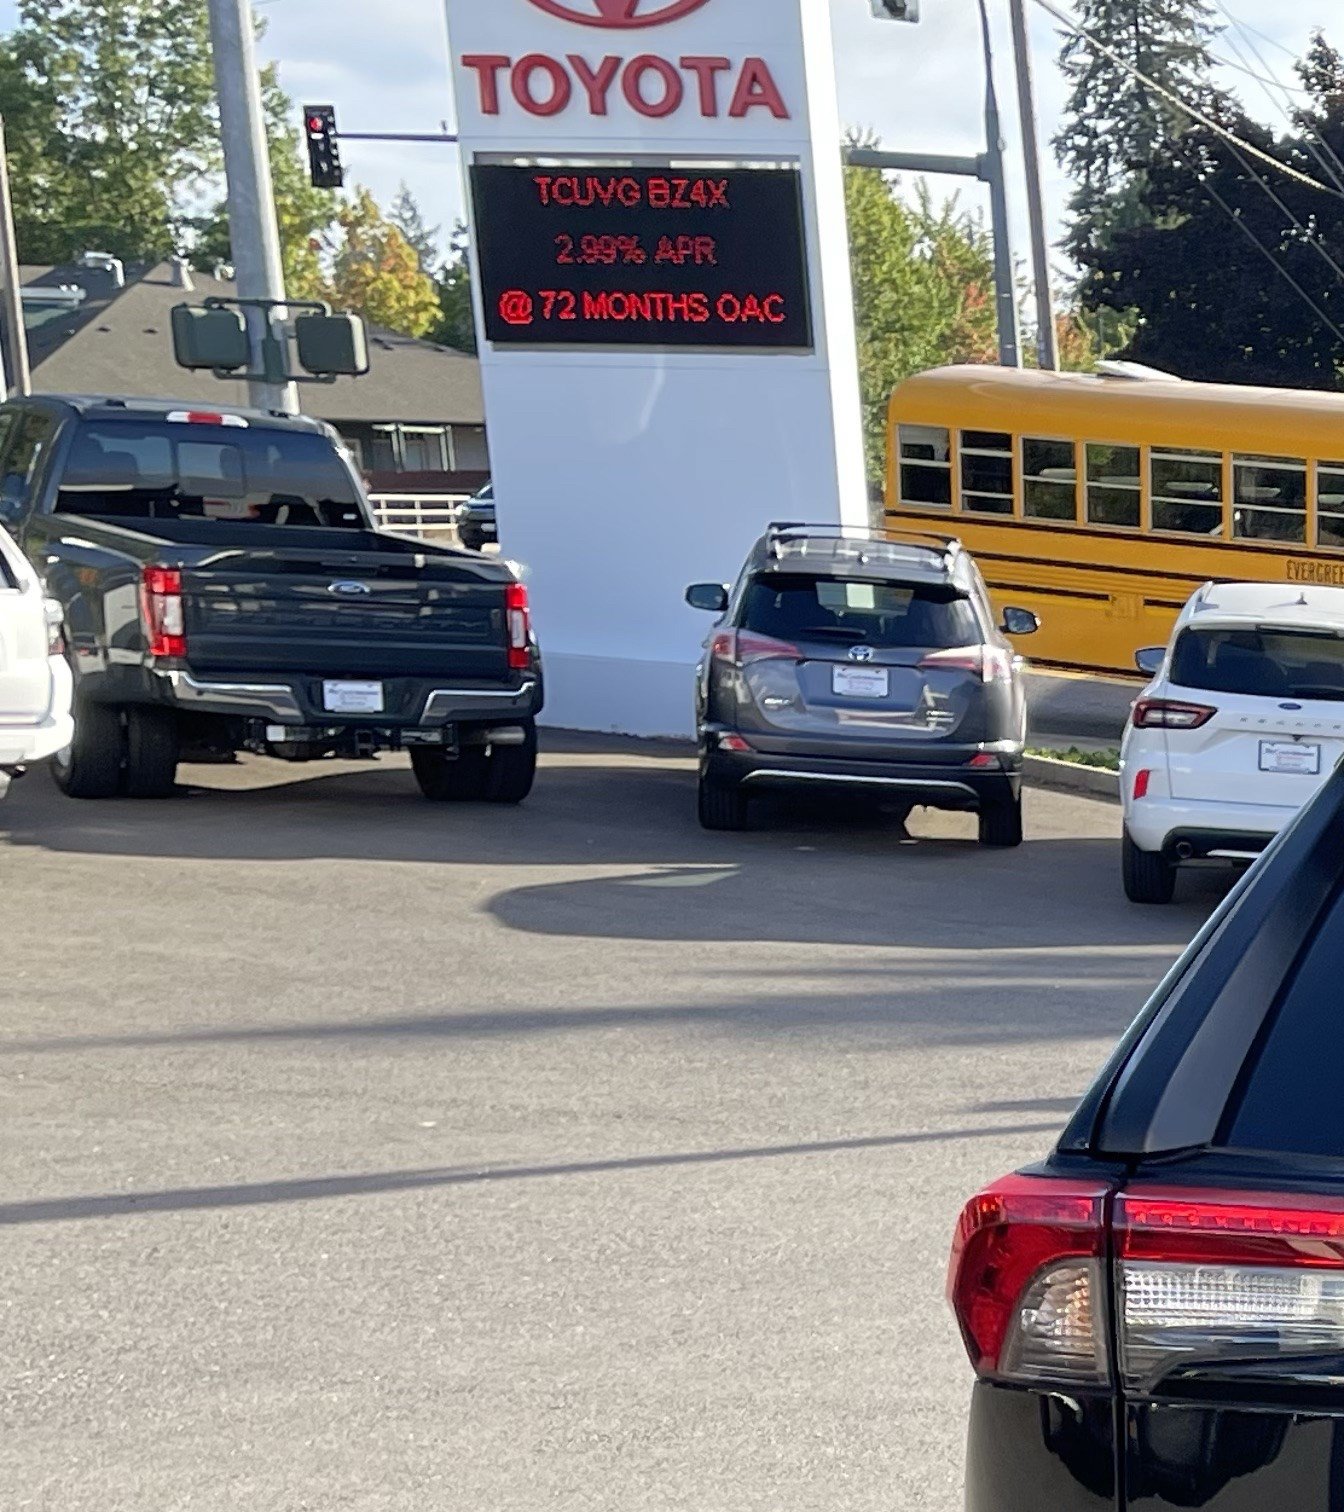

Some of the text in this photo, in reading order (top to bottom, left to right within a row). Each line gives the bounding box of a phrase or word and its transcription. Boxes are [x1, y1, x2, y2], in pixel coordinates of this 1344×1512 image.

[461, 54, 791, 120] TOYOTA
[647, 177, 731, 209] BZ4X
[554, 232, 719, 265] 2.99% APR
[499, 289, 787, 325] @ 72 MONTHS OAC
